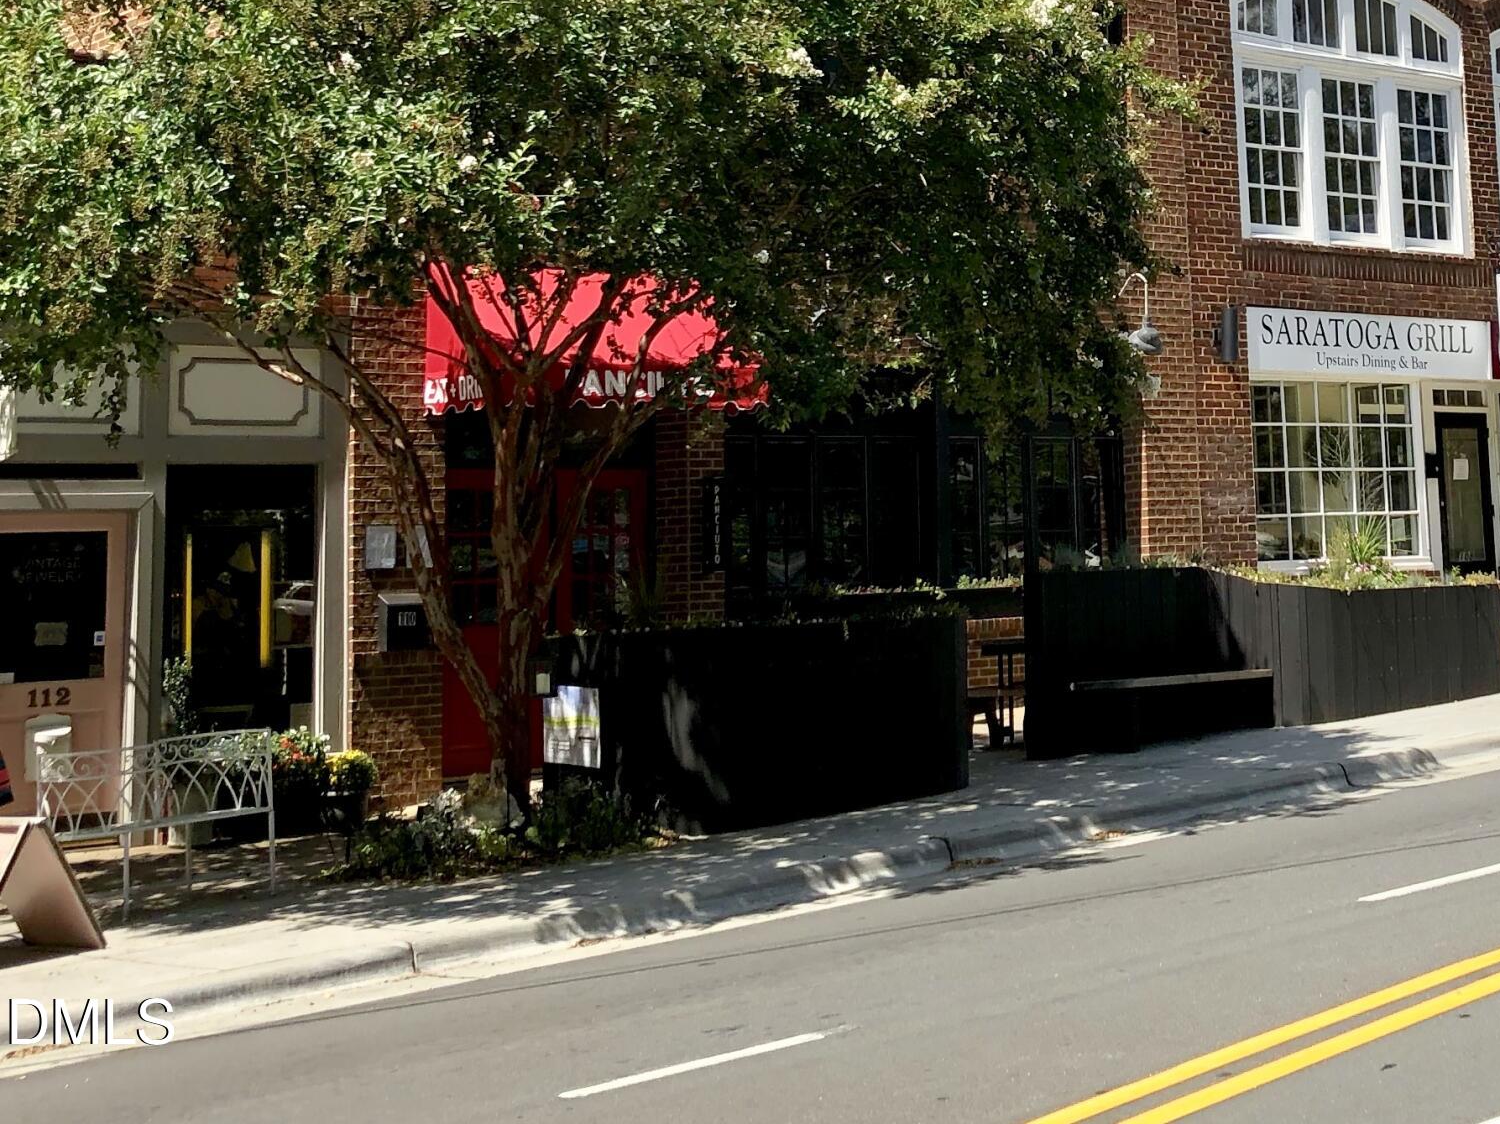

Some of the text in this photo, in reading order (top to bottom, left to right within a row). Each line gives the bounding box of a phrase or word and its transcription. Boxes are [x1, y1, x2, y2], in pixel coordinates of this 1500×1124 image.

[1261, 313, 1400, 350] SARATOGA
[1407, 322, 1474, 354] GRILL
[1316, 351, 1428, 372] Upstairs Dining & Bar
[424, 378, 449, 404] EAT
[27, 687, 71, 708] 112
